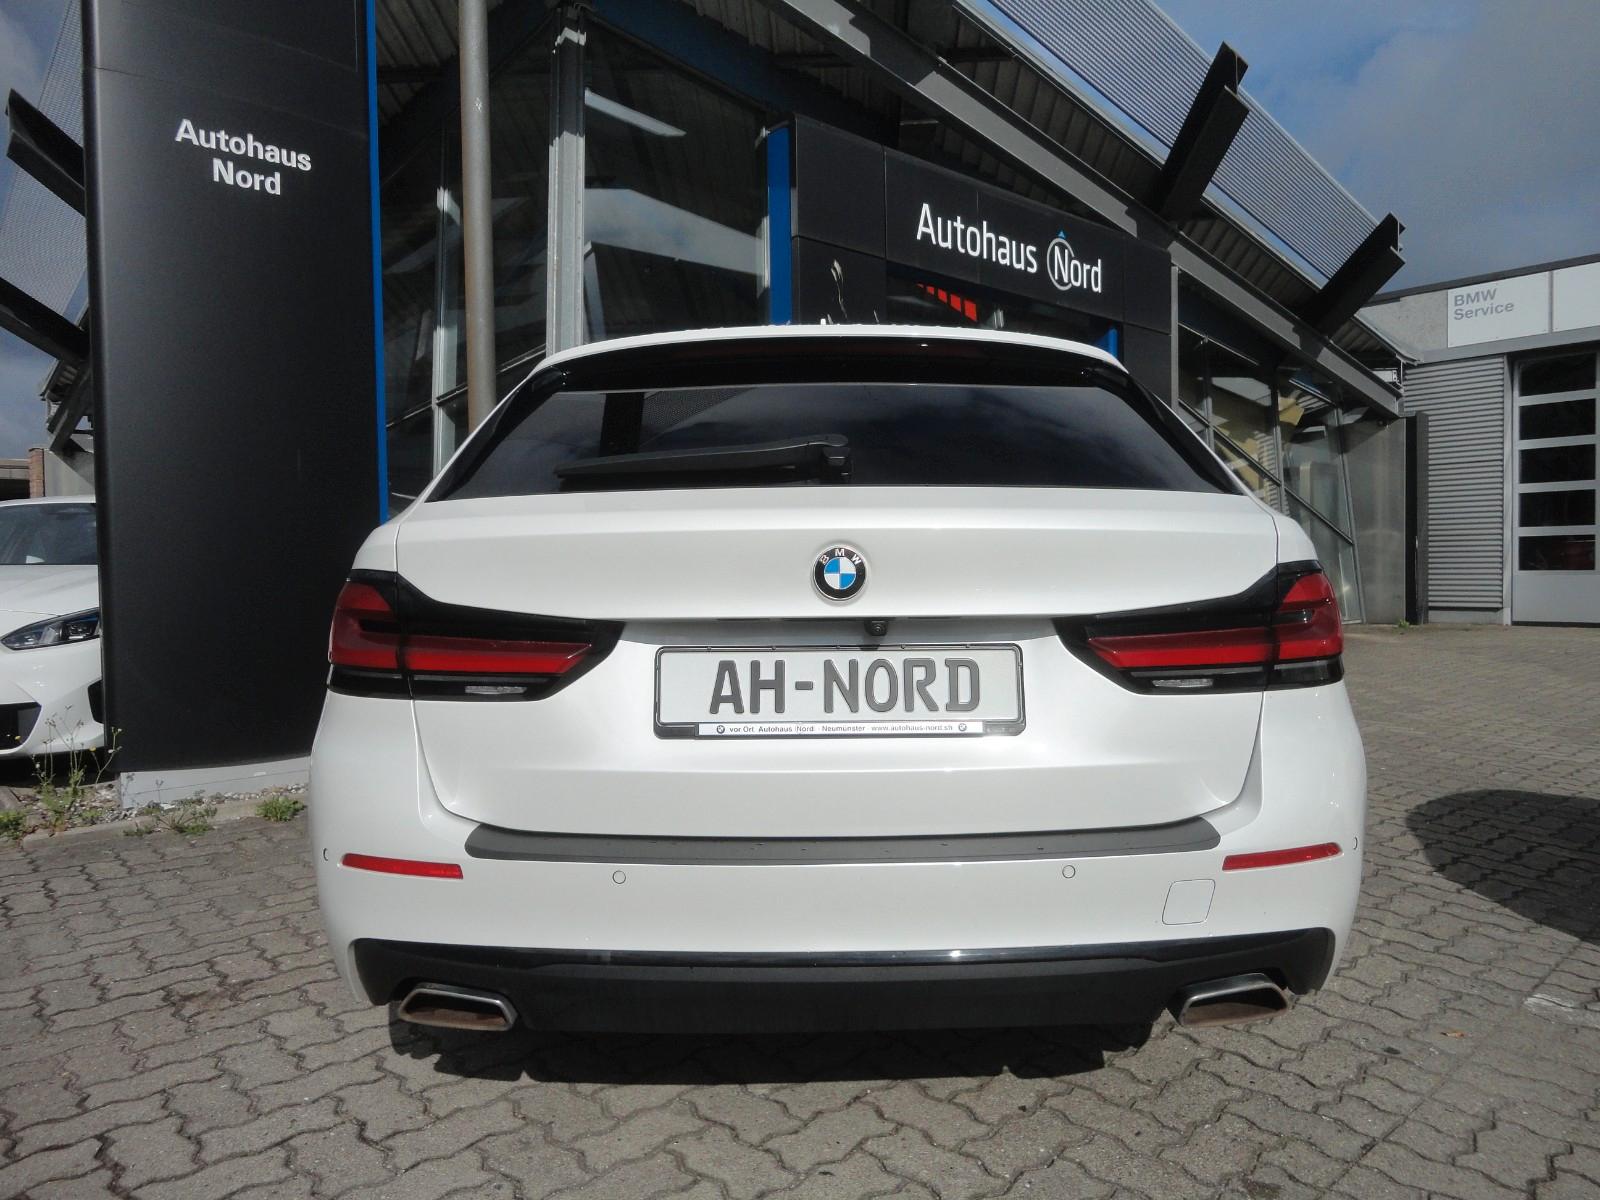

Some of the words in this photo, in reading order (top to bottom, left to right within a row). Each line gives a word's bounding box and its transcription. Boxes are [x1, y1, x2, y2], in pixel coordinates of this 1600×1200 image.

[174, 118, 312, 172] Autohaus
[212, 157, 281, 196] Nord
[916, 202, 1038, 274] Autohaus
[1053, 245, 1102, 293] Nord
[1453, 302, 1515, 321] Service
[1454, 288, 1497, 307] BMW
[820, 548, 862, 566] BMW
[709, 658, 981, 714] AH-NORD
[729, 725, 741, 733] vor
[743, 724, 754, 733] Ort
[758, 723, 793, 733] Autohaus
[796, 723, 815, 732] Nord
[822, 724, 866, 732] Neumünster
[871, 724, 953, 732] www.autohaus-nord.sh
